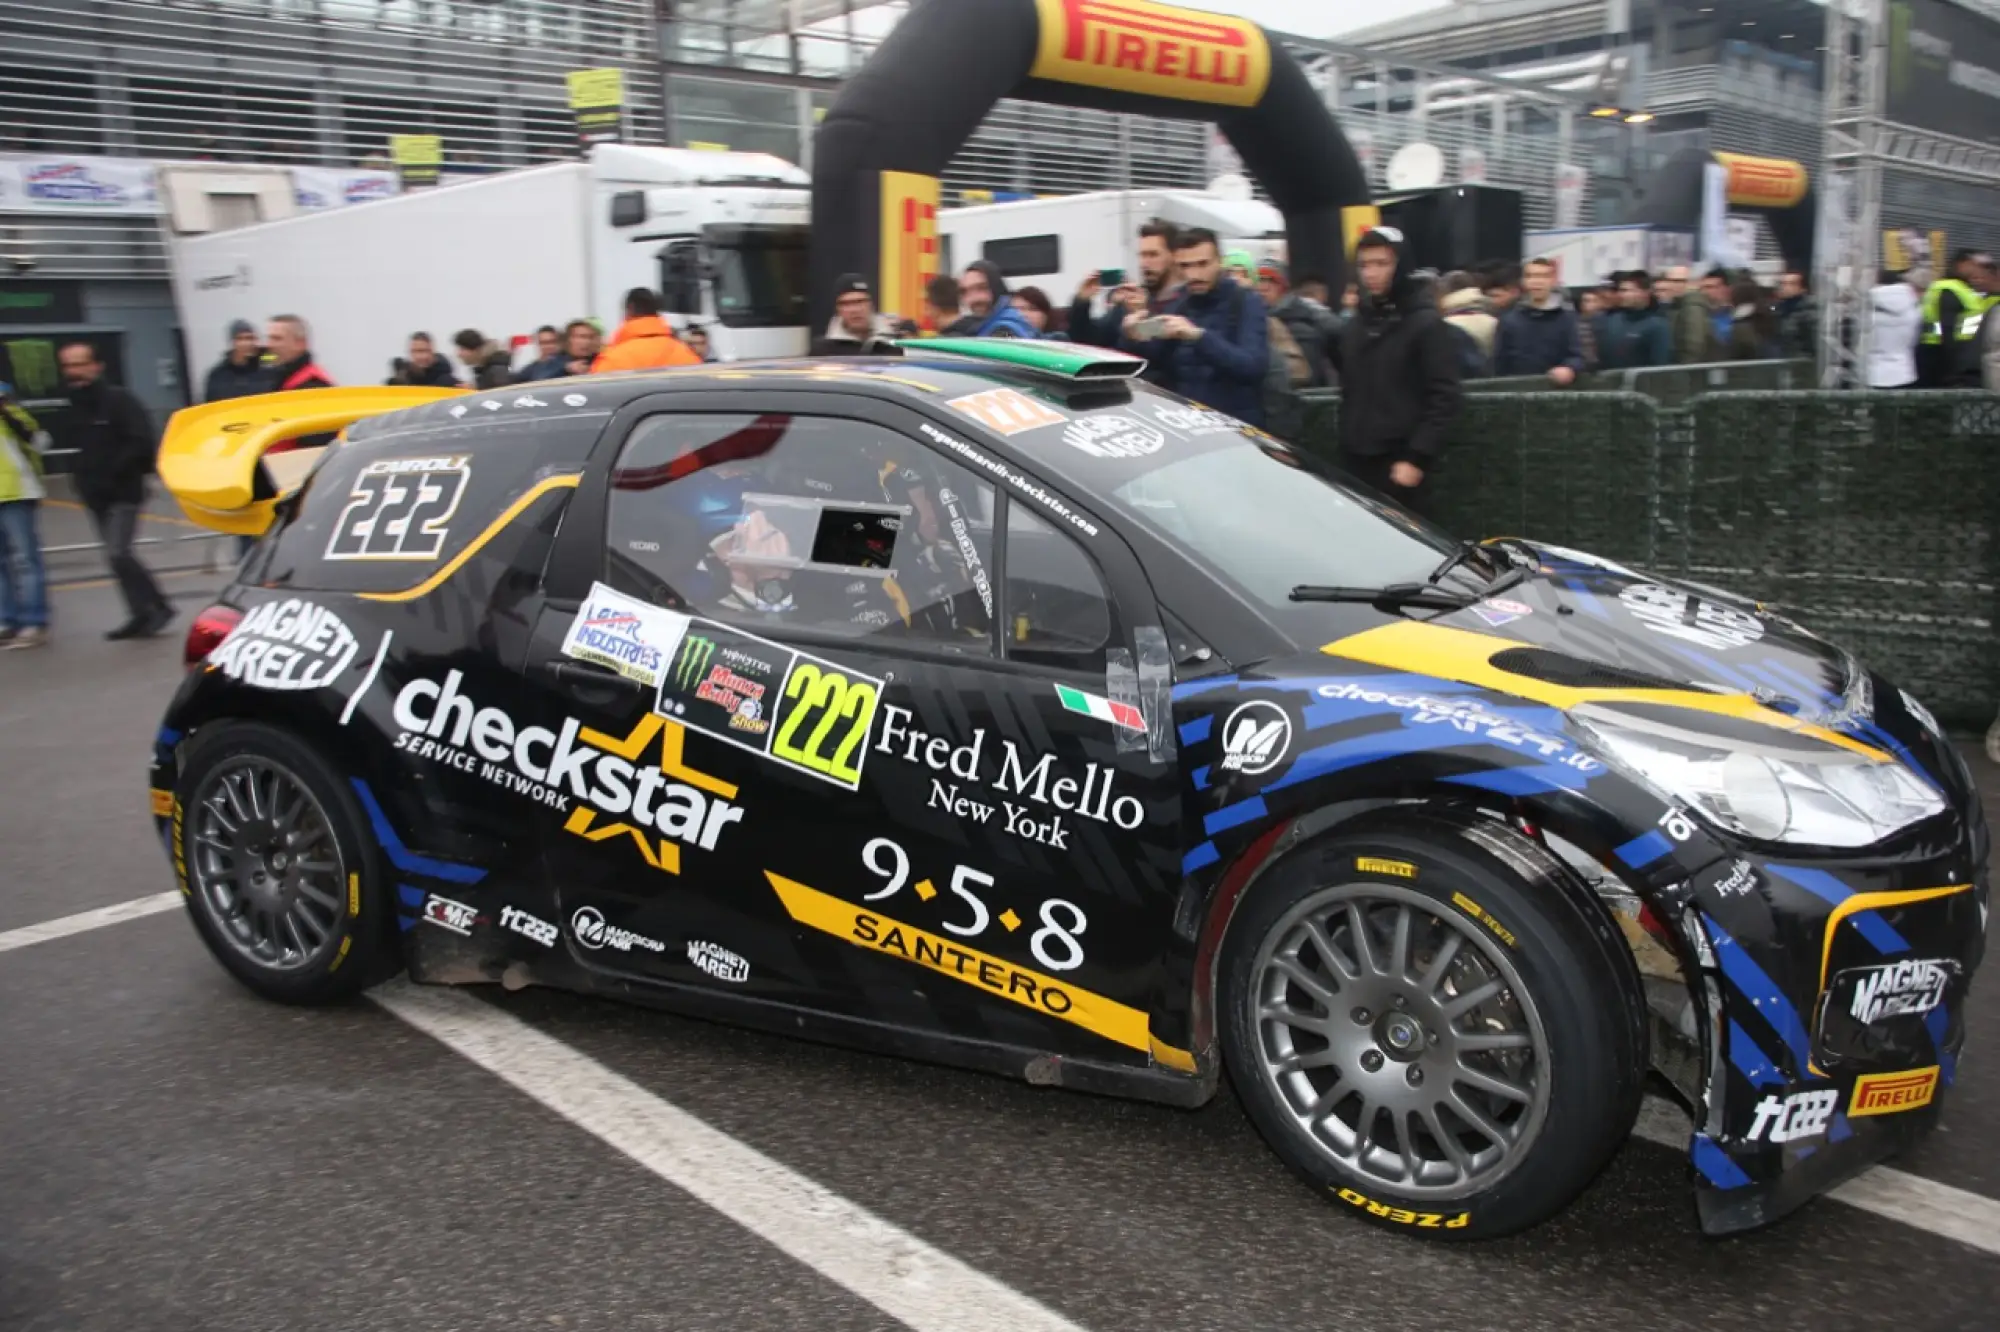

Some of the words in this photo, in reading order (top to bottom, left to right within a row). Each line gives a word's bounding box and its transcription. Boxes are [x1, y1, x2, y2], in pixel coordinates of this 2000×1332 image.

[1062, 0, 1247, 86] PIRELLI
[323, 464, 471, 560] 222
[393, 669, 744, 851] checkstar
[772, 664, 876, 785] 222
[874, 703, 985, 781] Fred
[992, 739, 1145, 830] Mello
[393, 732, 475, 774] SERVICE
[480, 762, 571, 812] NETWORK
[927, 778, 995, 824] New
[1003, 800, 1070, 850] York
[687, 939, 750, 972] MAGNETI
[852, 913, 1073, 1015] SANTERO
[1856, 1073, 1934, 1109] PIRELLI
